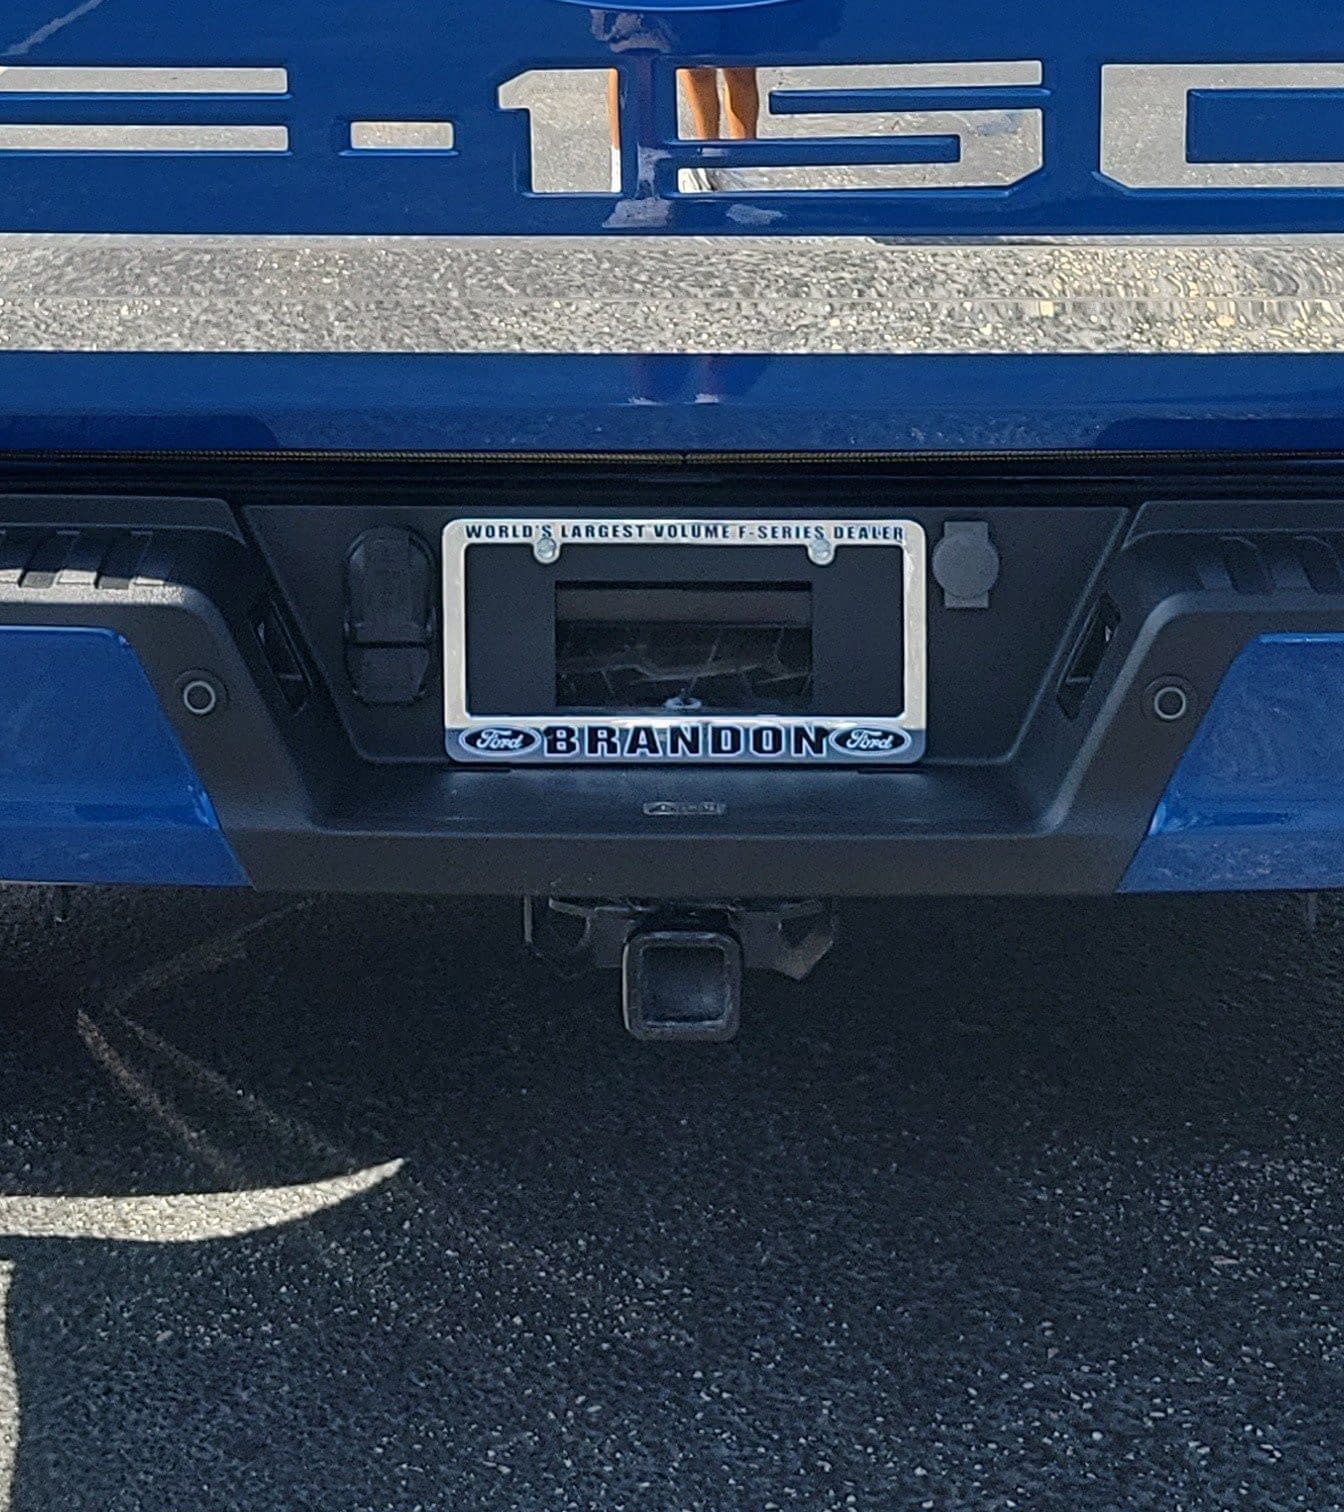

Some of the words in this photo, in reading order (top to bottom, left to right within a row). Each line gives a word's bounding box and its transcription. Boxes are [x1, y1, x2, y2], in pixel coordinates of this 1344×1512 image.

[465, 524, 552, 539] WORLD'S
[560, 524, 645, 539] LARGEST
[653, 524, 730, 539] VOLUME
[738, 525, 825, 540] F-SERIES
[832, 526, 904, 540] DEALER
[476, 728, 523, 749] Ford
[543, 724, 829, 756] BRANDON
[846, 728, 893, 749] Ford
